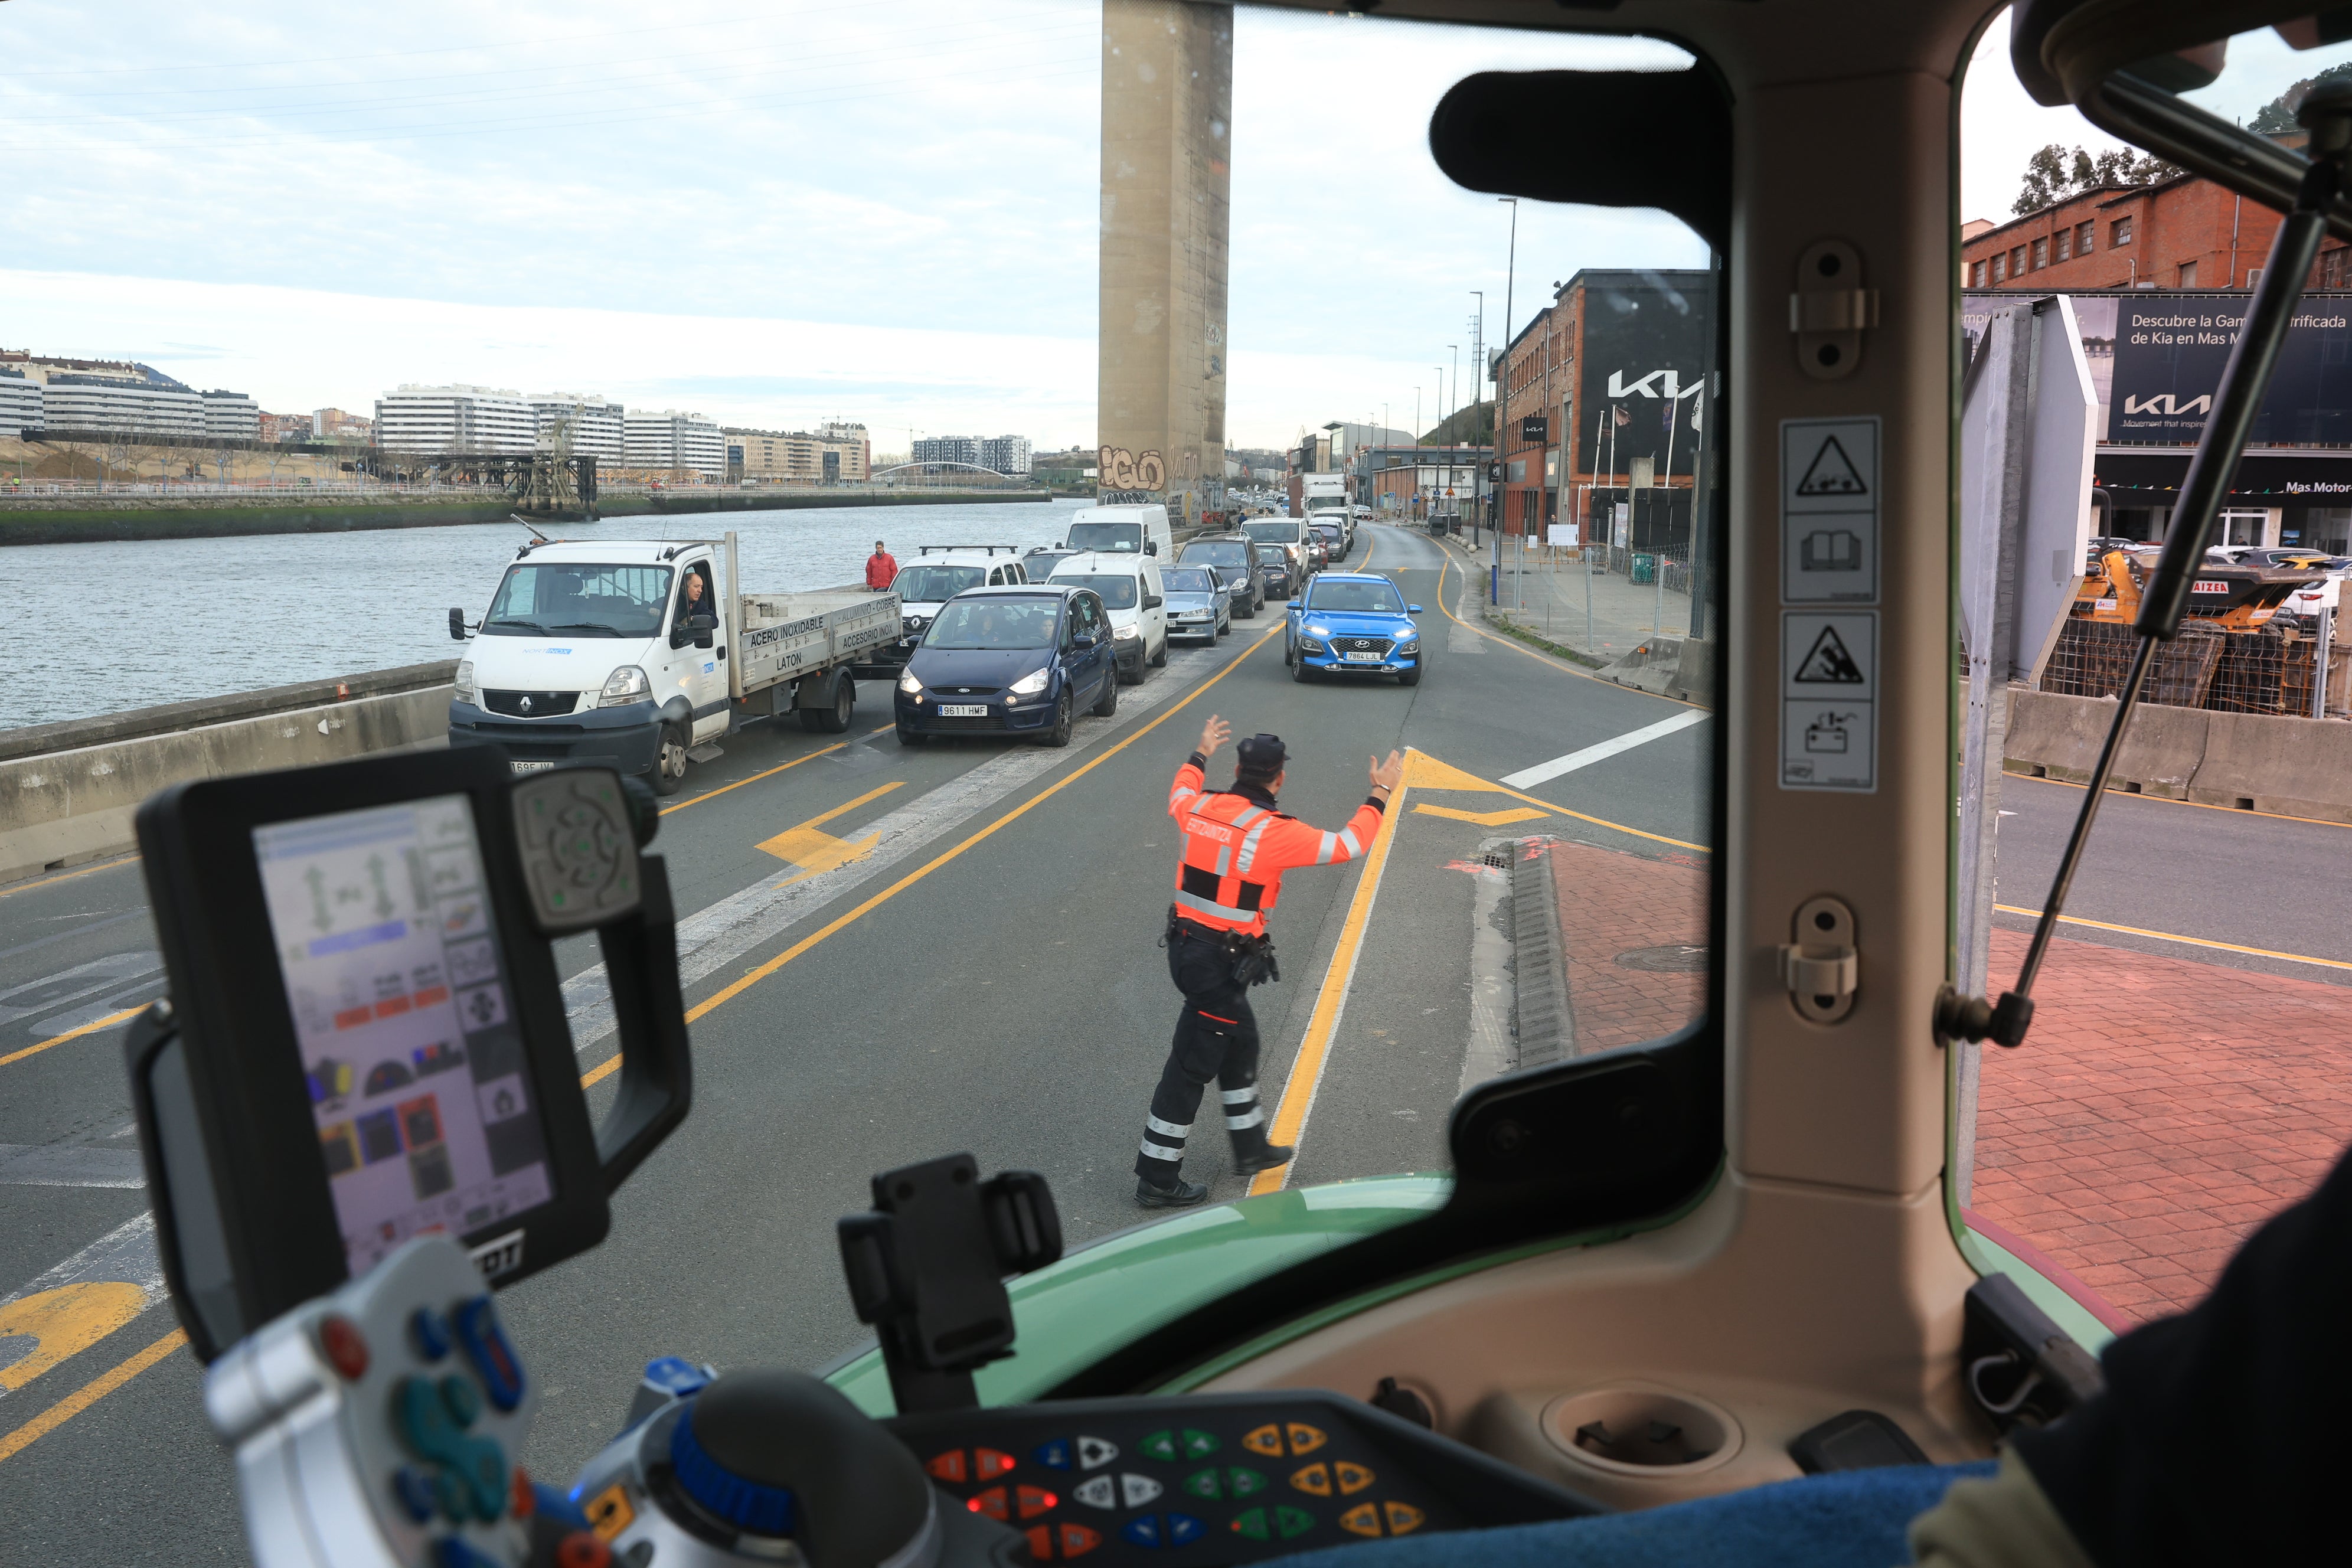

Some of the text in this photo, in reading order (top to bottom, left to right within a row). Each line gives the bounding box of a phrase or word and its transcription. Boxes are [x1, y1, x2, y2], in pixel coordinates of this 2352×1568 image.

[2132, 315, 2196, 327] Descubre
[2200, 315, 2211, 327] la
[2216, 315, 2247, 328] Gam
[2131, 332, 2148, 344] de
[2152, 332, 2173, 344] Kia
[2177, 335, 2194, 344] en
[2198, 332, 2226, 345] Mas
[2124, 394, 2211, 415] KIA
[2286, 482, 2311, 492] Mas
[2193, 583, 2227, 592] AIZEA
[751, 629, 778, 648] ACERO
[780, 617, 823, 638] INOXIDABLE
[842, 603, 871, 622] ALUMINIO
[877, 597, 896, 612] COBRE
[777, 652, 802, 671] LATON
[843, 628, 878, 649] ACCESORIO
[879, 623, 893, 638] INOX
[944, 707, 985, 715] 9611 HMF
